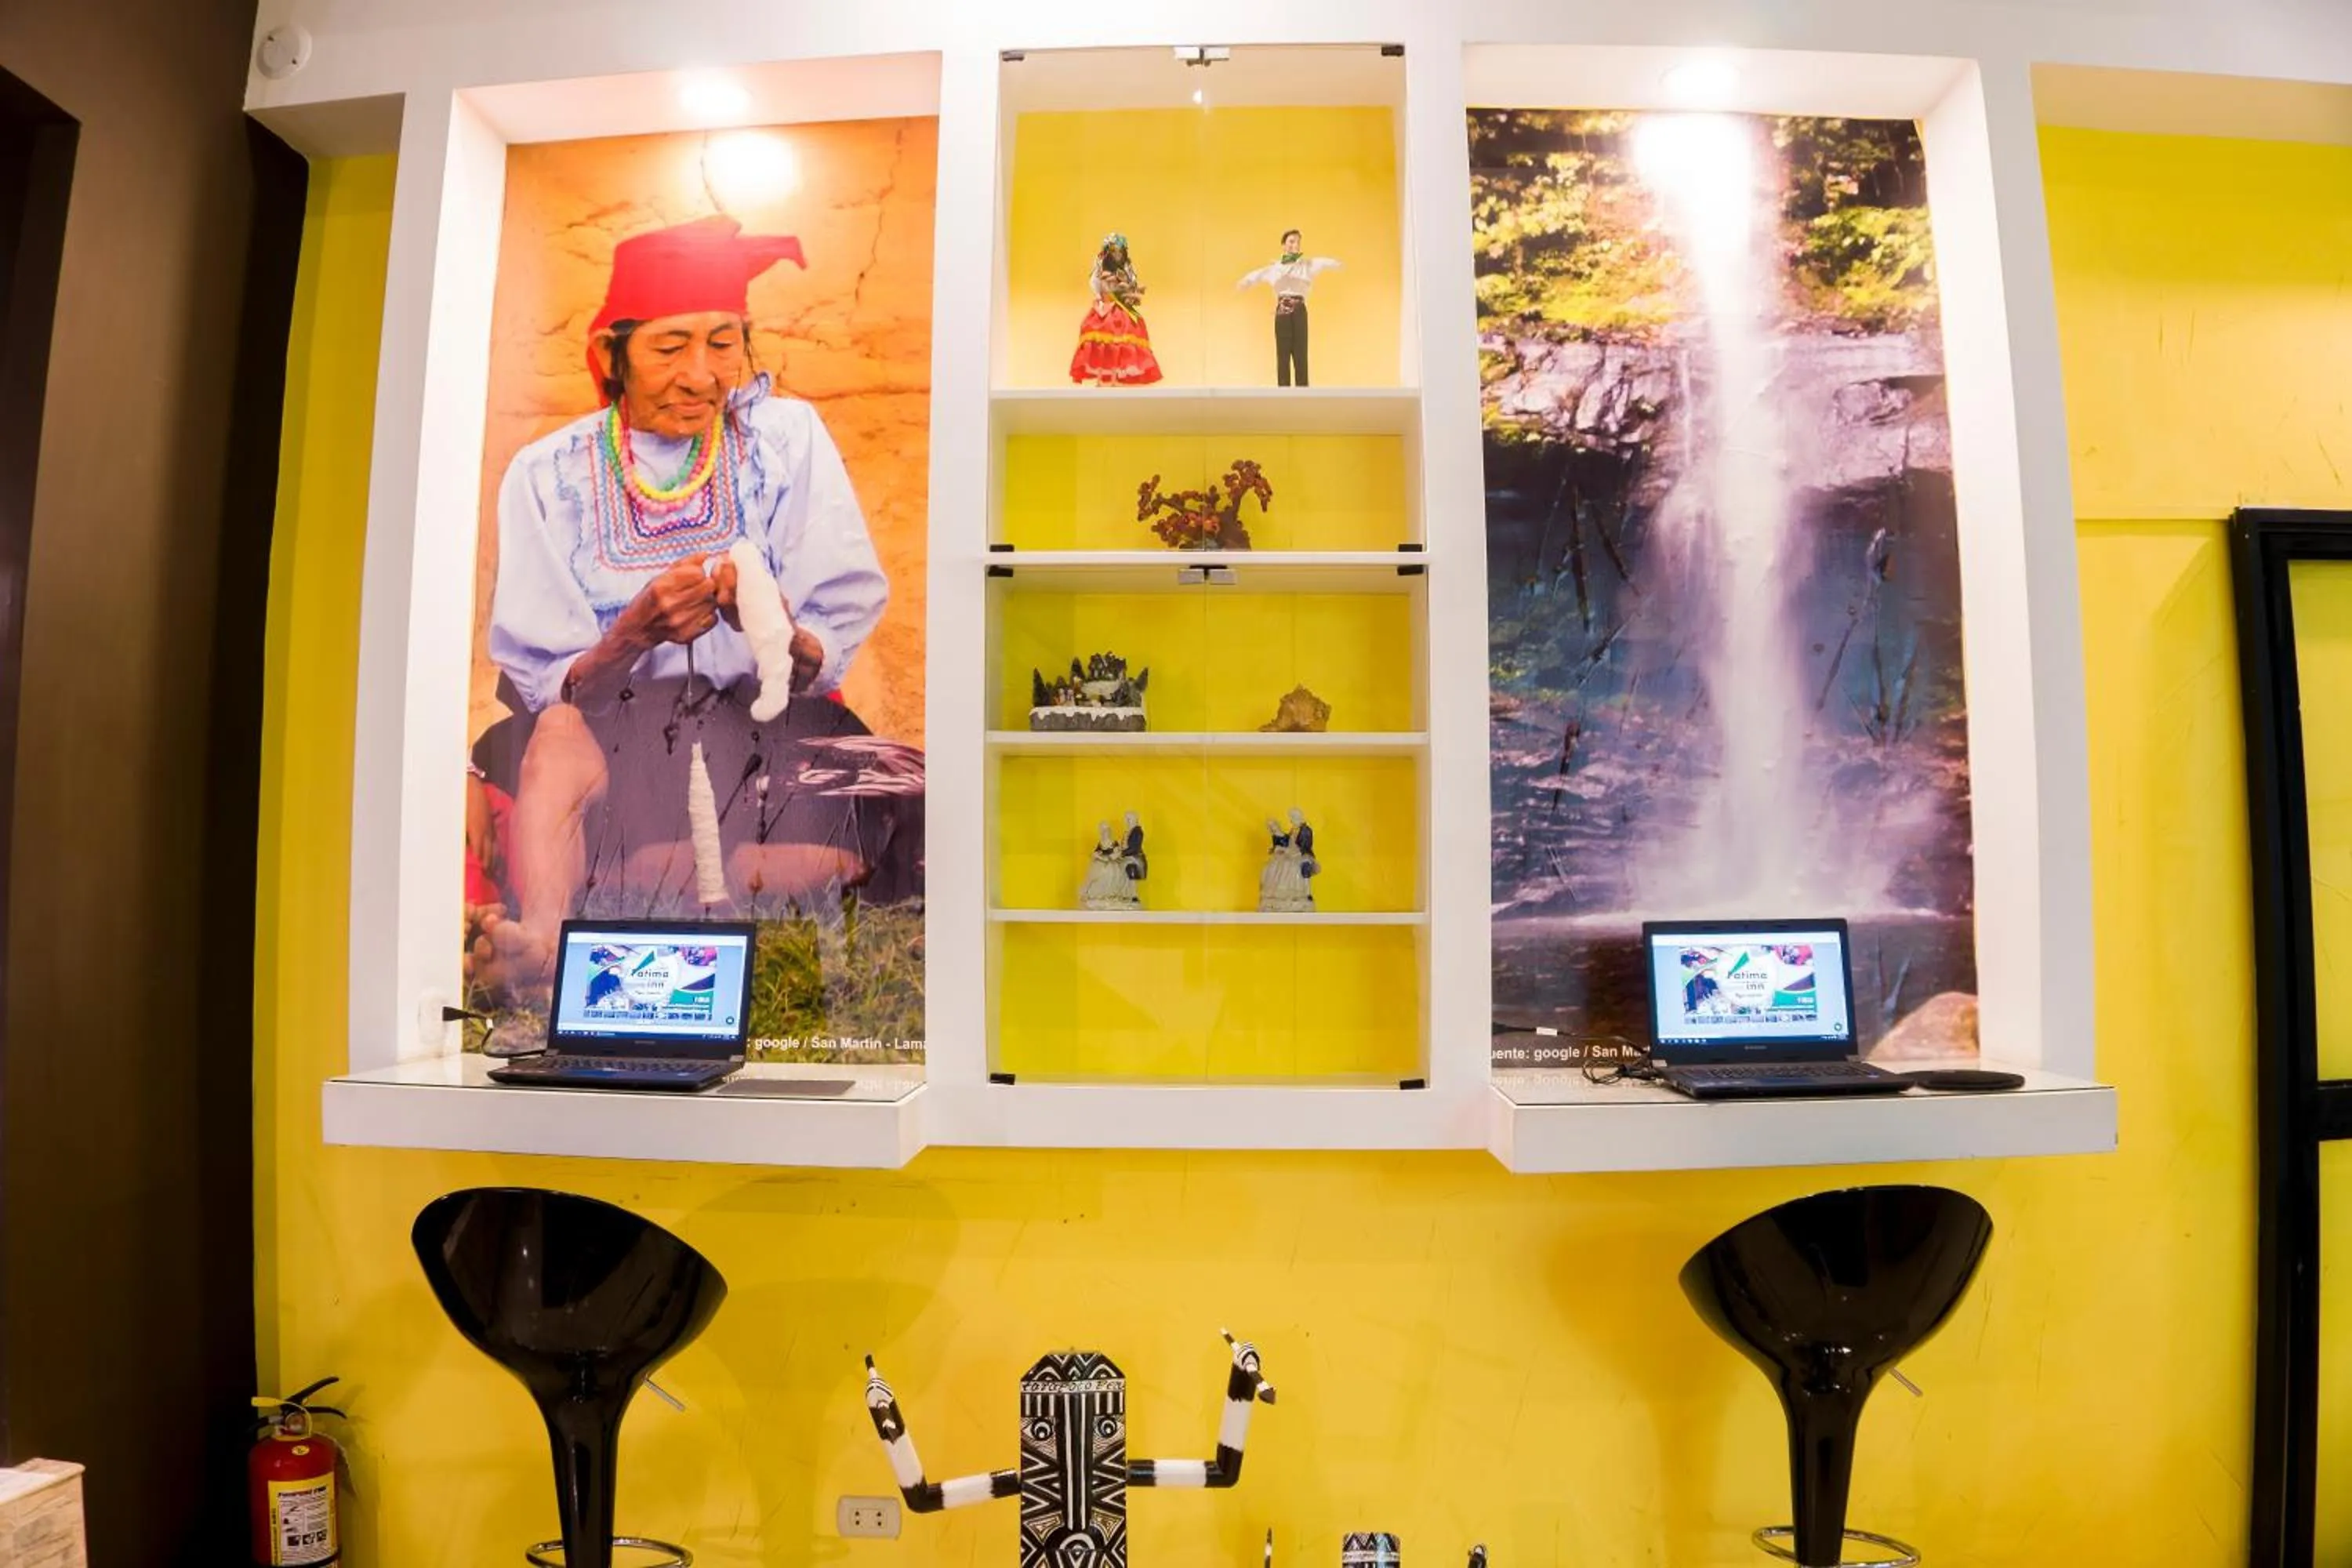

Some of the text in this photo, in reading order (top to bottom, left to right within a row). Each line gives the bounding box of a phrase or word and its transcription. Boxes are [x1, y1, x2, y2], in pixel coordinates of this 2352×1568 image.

[754, 1036, 800, 1051] google
[811, 1036, 837, 1049] San
[840, 1036, 882, 1050] Martin
[1534, 1046, 1580, 1062] google
[1592, 1045, 1617, 1058] San
